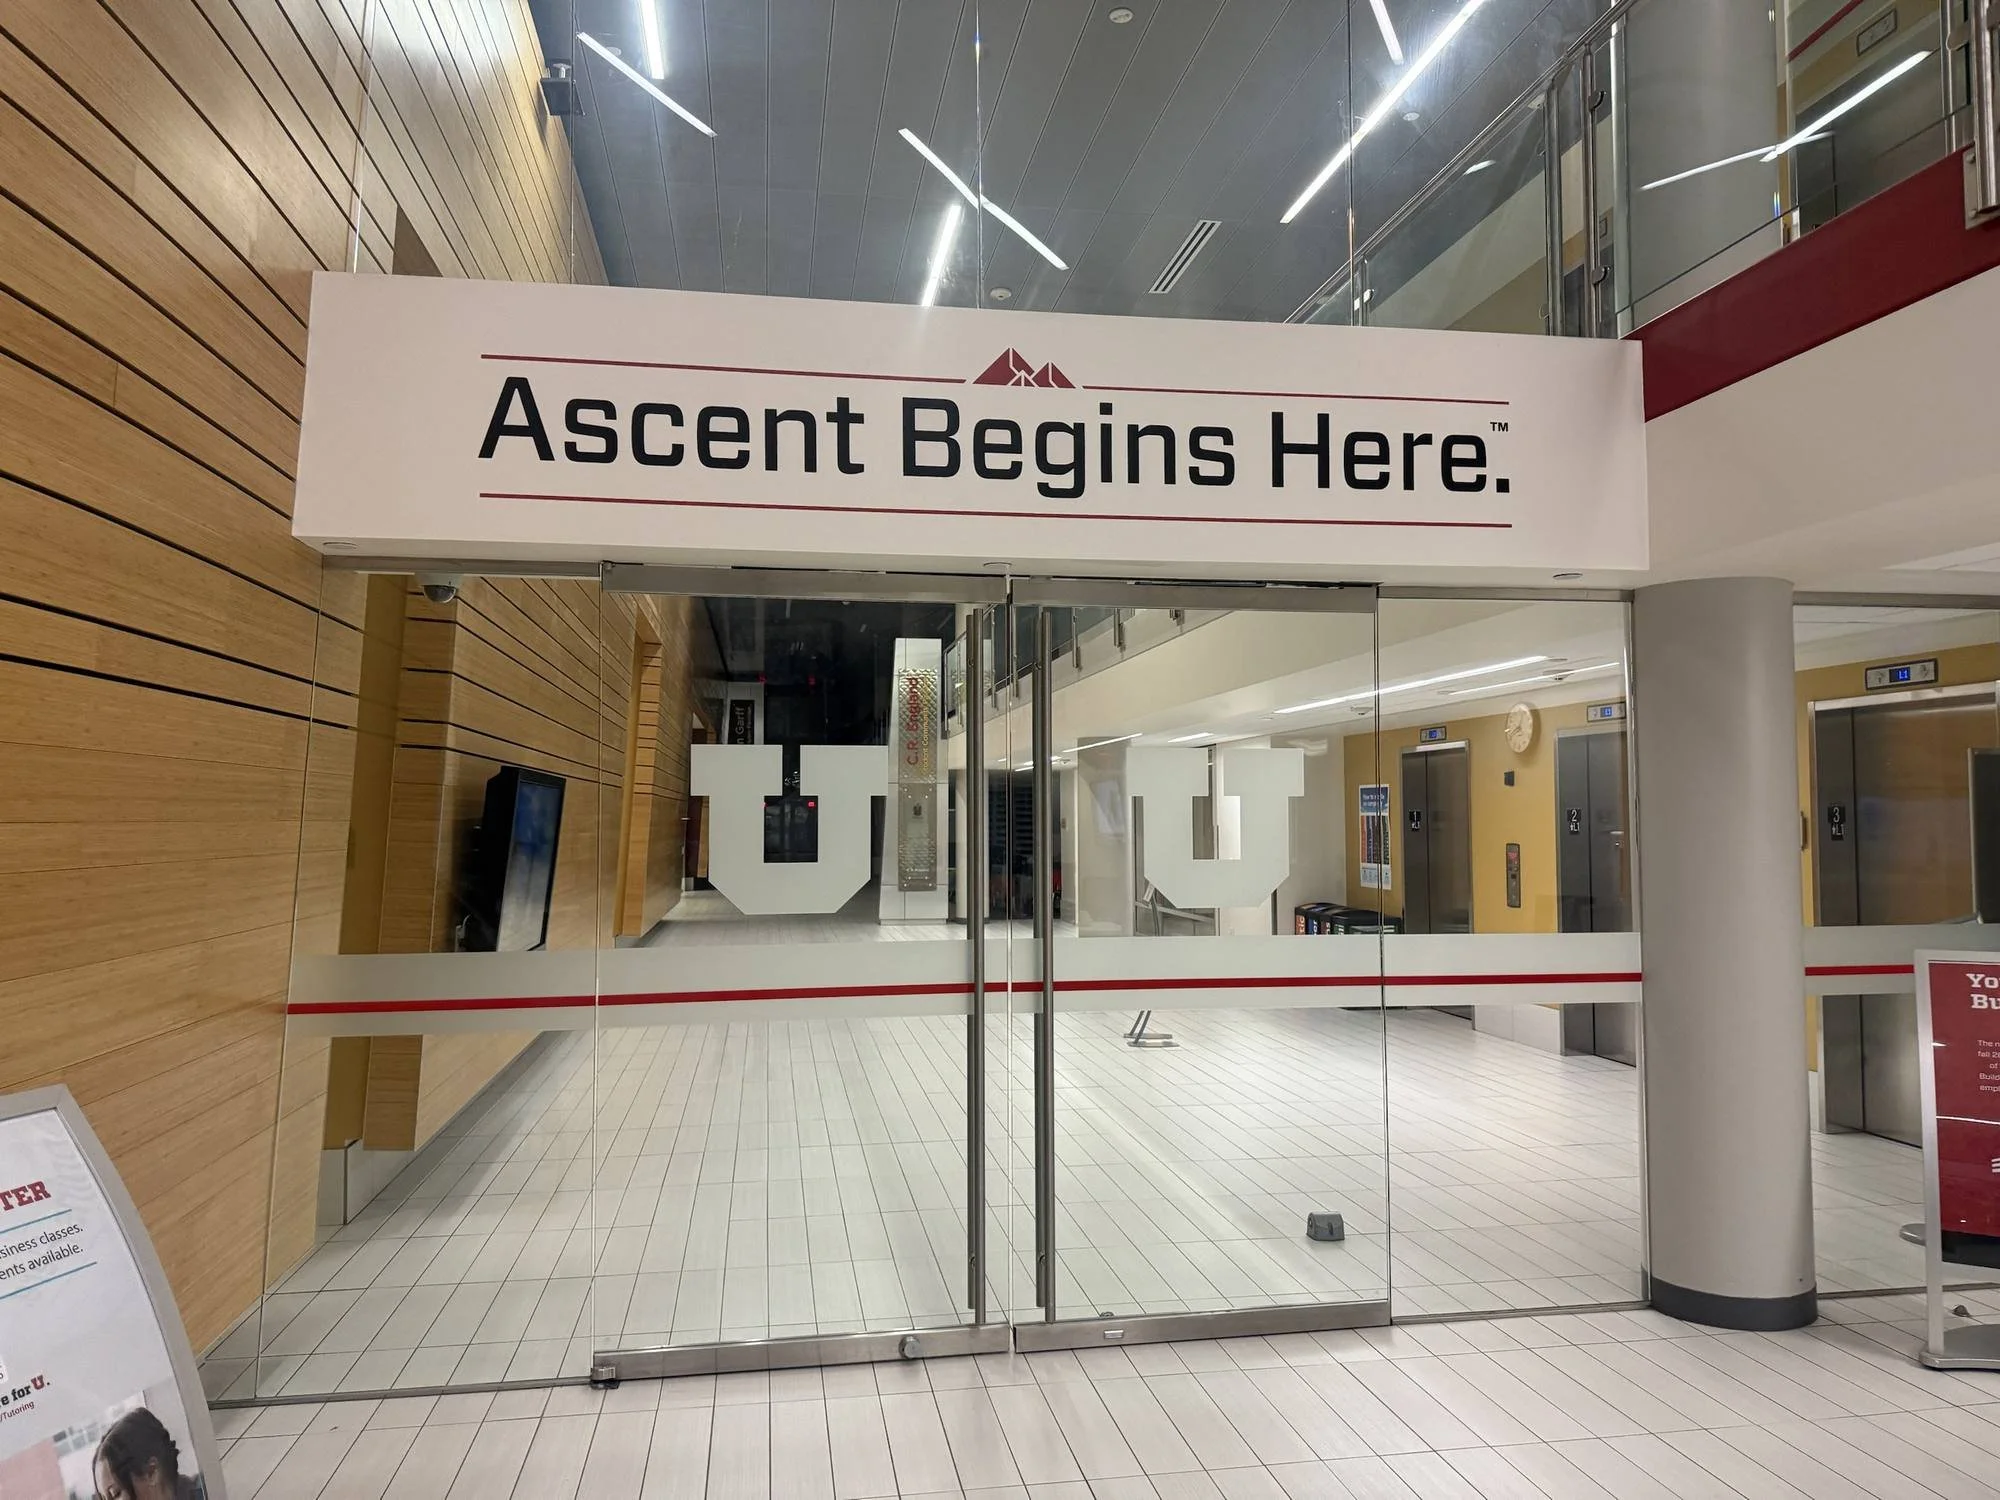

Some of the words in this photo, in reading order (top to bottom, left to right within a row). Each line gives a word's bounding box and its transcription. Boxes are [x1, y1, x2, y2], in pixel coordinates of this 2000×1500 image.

[478, 376, 865, 475] Ascent
[902, 397, 1236, 499] Begins
[1271, 411, 1511, 494] Here.
[735, 706, 745, 735] Garff
[1125, 746, 1305, 909] U
[1571, 809, 1577, 822] 2
[1833, 806, 1840, 823] 3
[690, 744, 890, 915] U
[1966, 973, 2000, 989] Yo
[1977, 1039, 1993, 1047] The
[0, 1181, 52, 1211] TER
[0, 1238, 38, 1259] siness
[39, 1222, 84, 1245] classes.
[0, 1263, 26, 1281] ents
[28, 1243, 84, 1270] available.
[11, 1385, 31, 1402] for
[0, 1401, 35, 1422] /Tutoring
